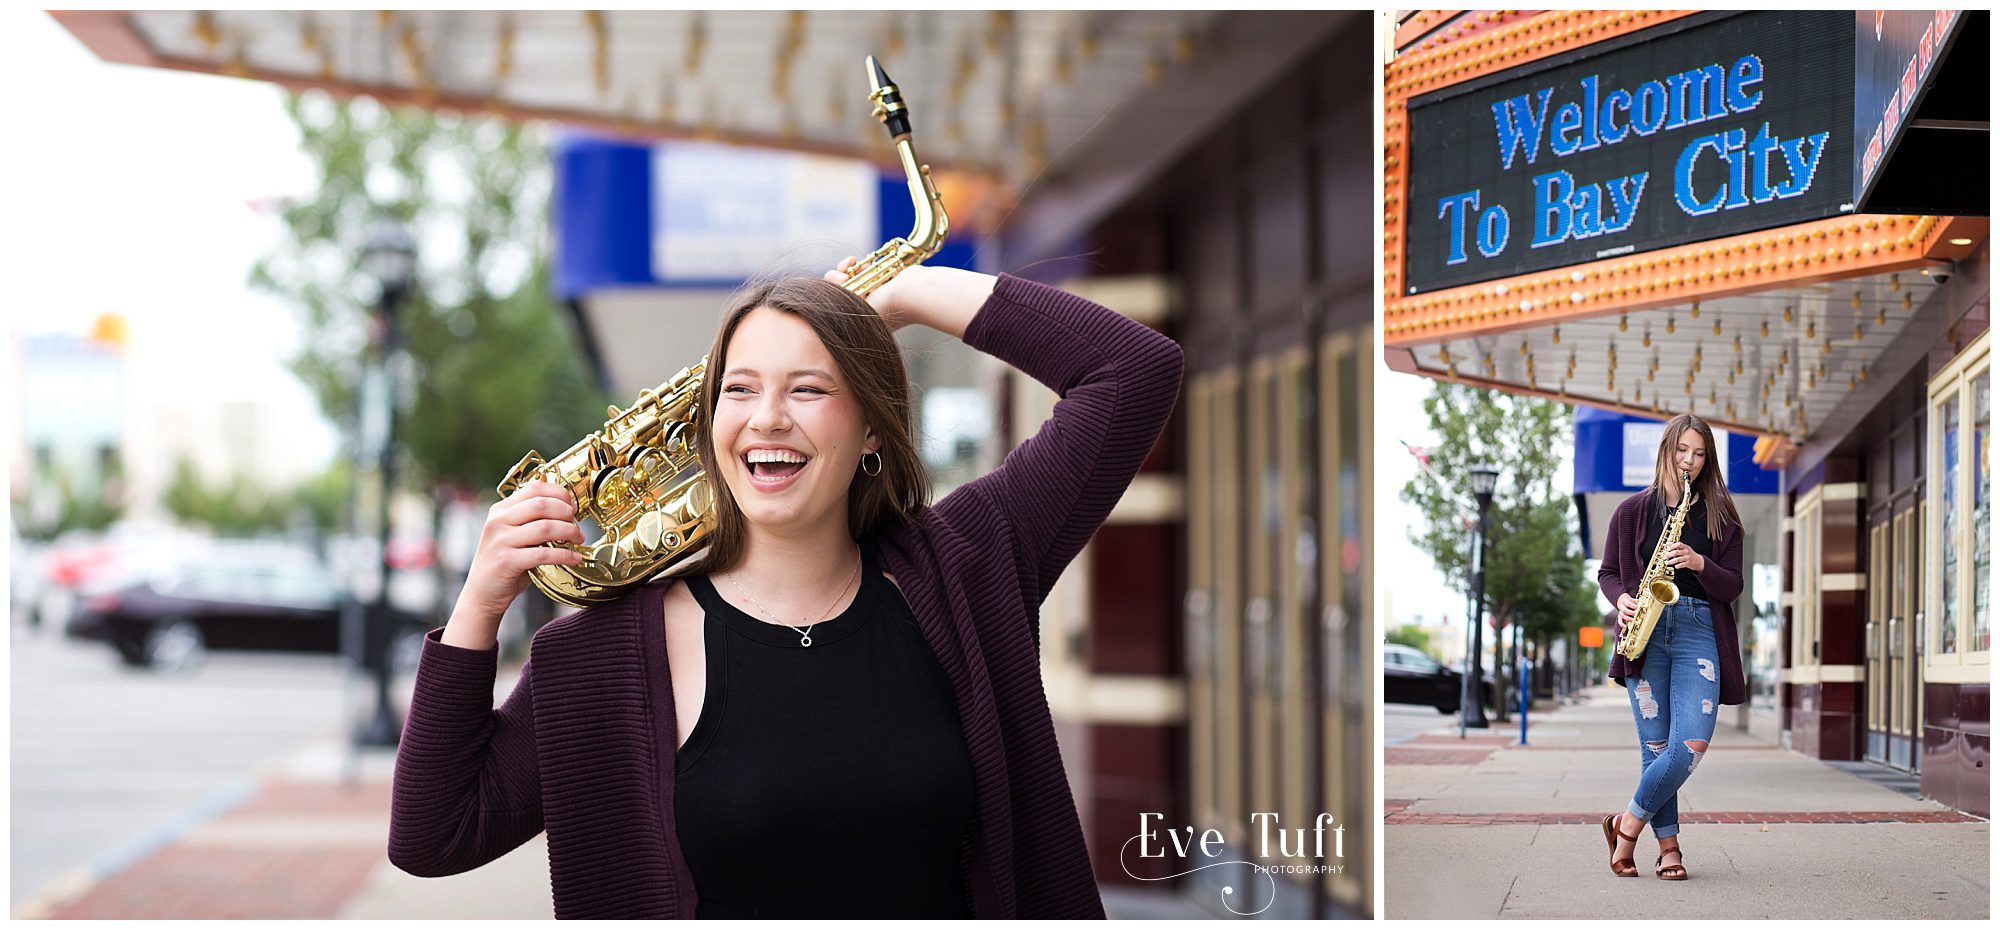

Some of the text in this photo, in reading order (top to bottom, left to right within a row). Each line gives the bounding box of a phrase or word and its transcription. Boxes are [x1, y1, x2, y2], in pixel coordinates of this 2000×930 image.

[1492, 54, 1763, 169] Welcome
[1439, 190, 1510, 264] To
[1531, 171, 1649, 248] Bay
[1675, 123, 1829, 216] City
